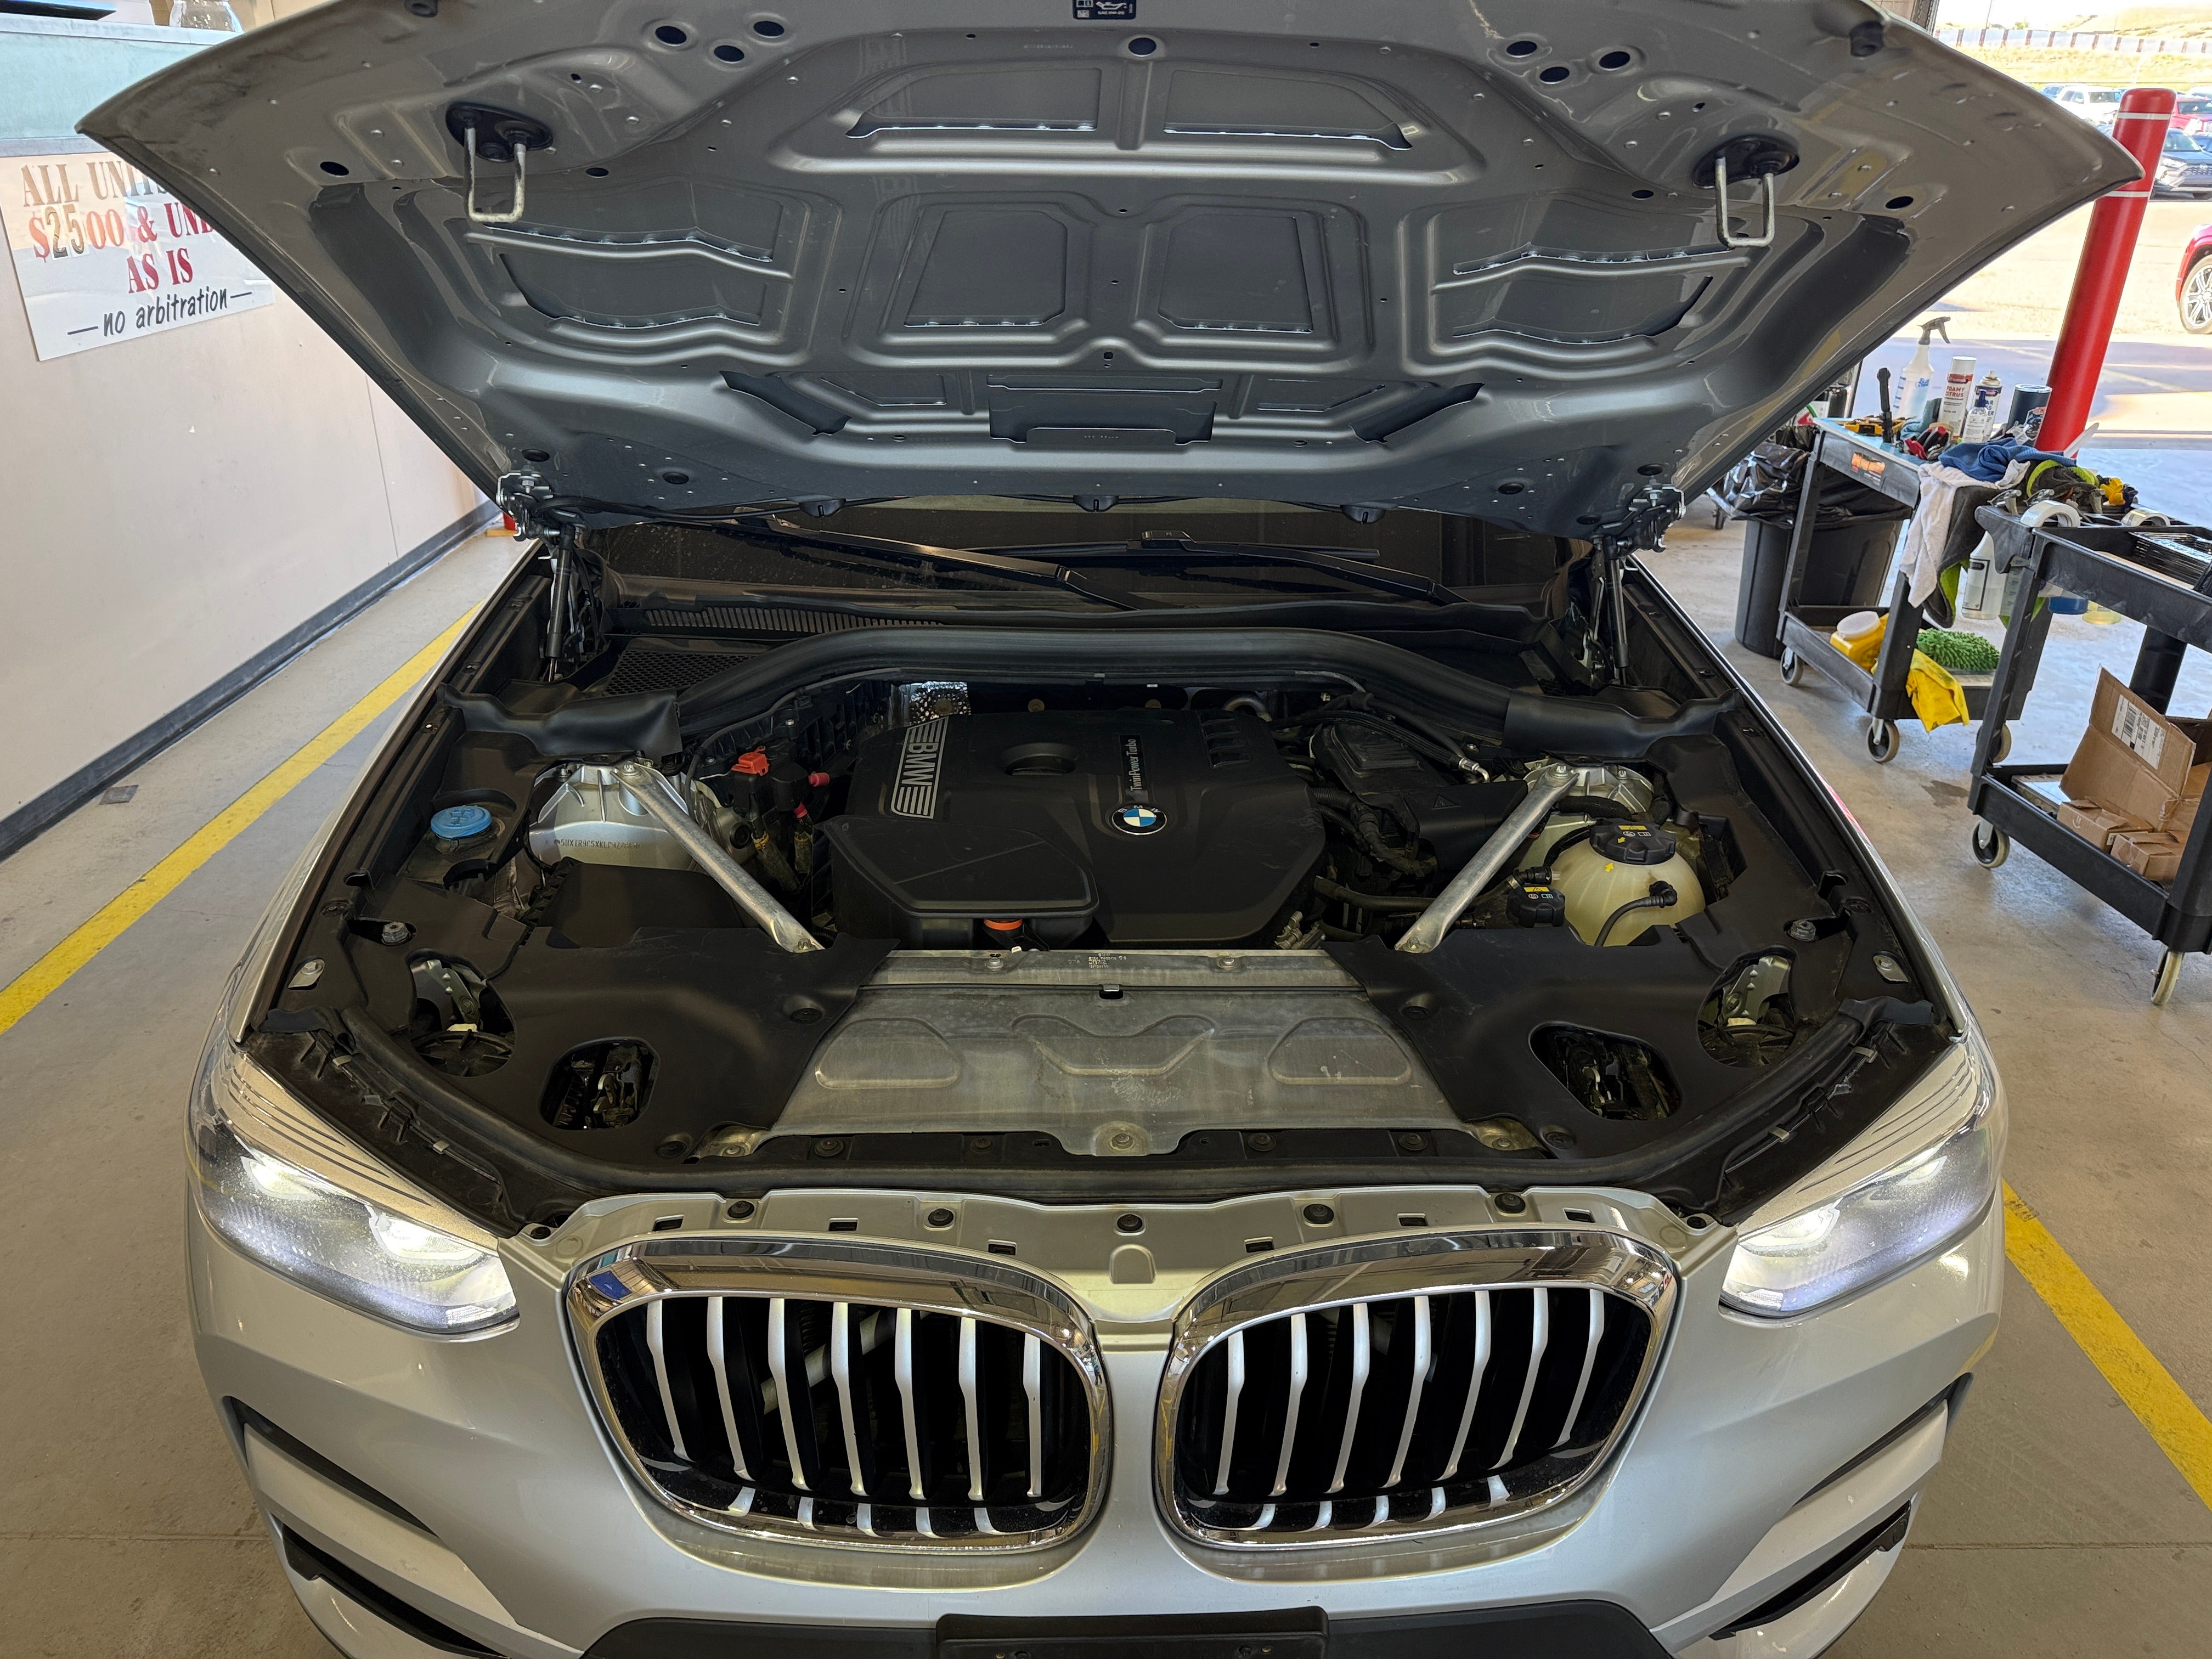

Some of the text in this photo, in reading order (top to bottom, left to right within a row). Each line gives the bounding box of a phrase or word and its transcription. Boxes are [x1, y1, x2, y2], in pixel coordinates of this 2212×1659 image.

[21, 164, 79, 207] ALL
[29, 203, 125, 263] $2500
[137, 206, 157, 243] &
[126, 248, 193, 294] AS IS
[104, 286, 227, 337] no arbitration
[901, 742, 939, 786] BMW
